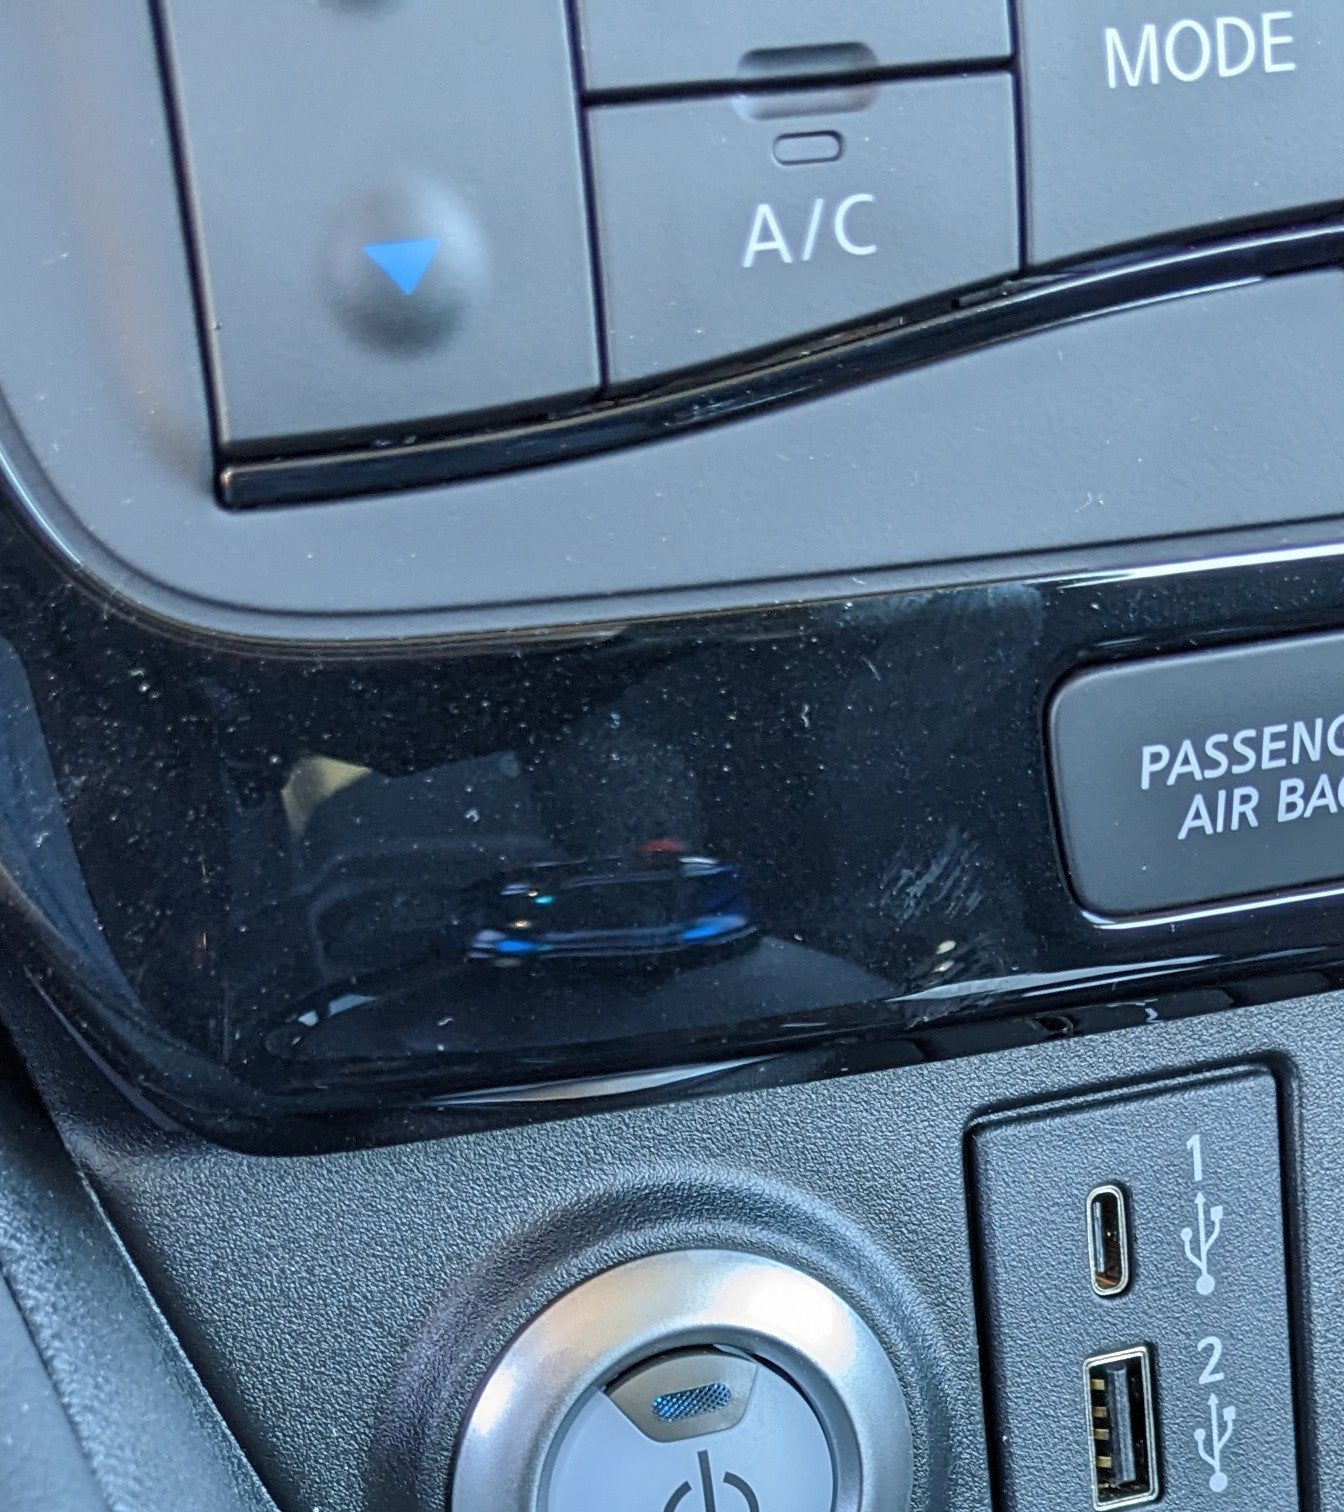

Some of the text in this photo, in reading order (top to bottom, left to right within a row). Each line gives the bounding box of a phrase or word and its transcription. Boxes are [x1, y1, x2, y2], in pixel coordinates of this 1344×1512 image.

[1105, 11, 1296, 89] MODE
[743, 194, 877, 268] A/C
[1177, 787, 1259, 841] AIR
[1185, 1134, 1204, 1181] 1
[1197, 1336, 1224, 1385] 2
